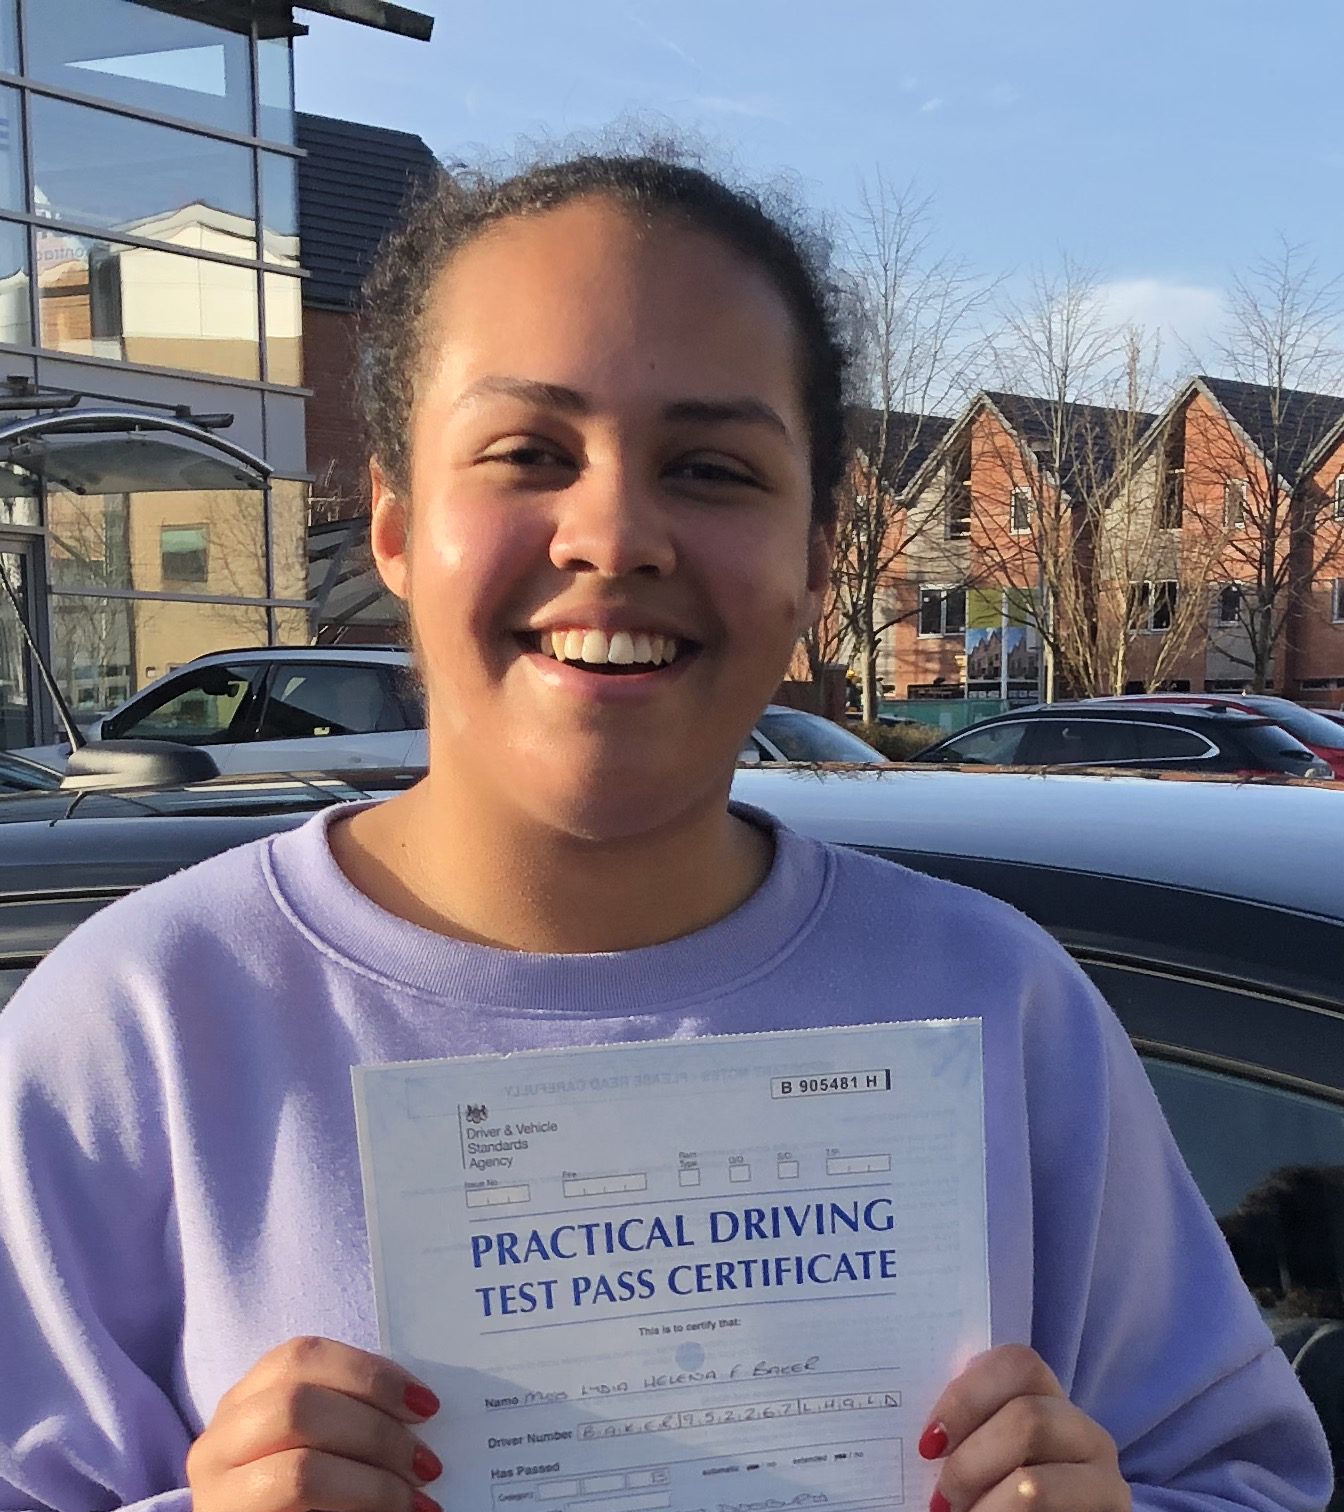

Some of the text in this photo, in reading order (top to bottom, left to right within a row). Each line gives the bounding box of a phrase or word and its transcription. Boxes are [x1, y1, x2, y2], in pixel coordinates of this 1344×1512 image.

[781, 1075, 878, 1095] B 905481 H
[467, 1121, 558, 1140] Driver & Vehicle
[468, 1138, 529, 1154] Standards
[469, 1155, 513, 1171] Agency
[470, 1198, 896, 1268] PRACTICAL DRIVING
[475, 1248, 898, 1317] TEST PASS CERTIFICATE
[639, 1326, 660, 1337] This
[662, 1325, 671, 1335] is
[674, 1324, 683, 1333] to
[686, 1319, 716, 1332] certify
[485, 1395, 519, 1409] Name
[488, 1430, 573, 1450] Driver Number
[490, 1461, 560, 1478] Has Passed
